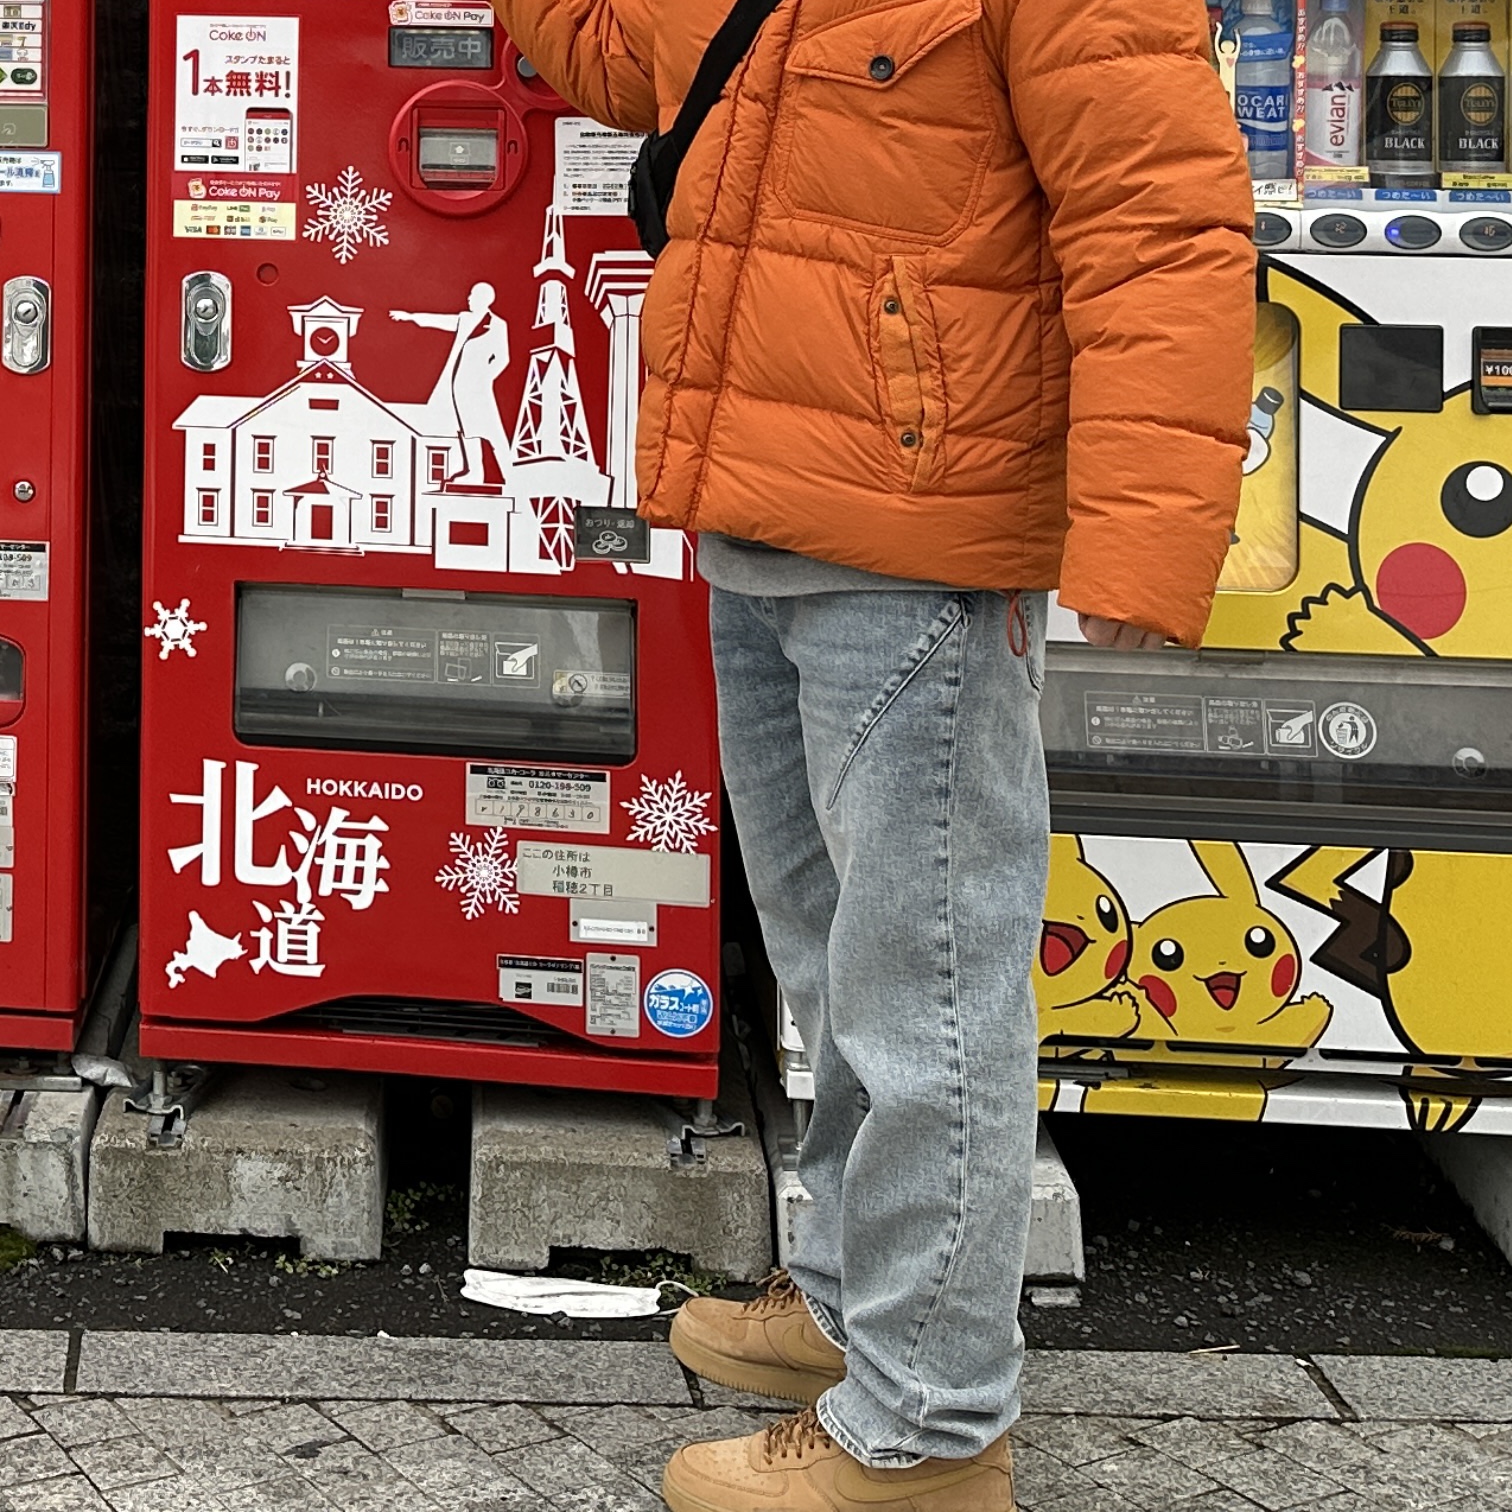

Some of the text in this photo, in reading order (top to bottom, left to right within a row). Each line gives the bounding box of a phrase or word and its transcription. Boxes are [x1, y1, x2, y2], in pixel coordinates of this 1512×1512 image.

[414, 9, 486, 24] Coke ON Pay
[209, 28, 267, 43] Coke ON
[401, 36, 482, 60] 販売中
[224, 54, 291, 65] スタンプたまると
[182, 48, 292, 99] 1本無料!
[1328, 92, 1346, 148] evian
[1384, 137, 1426, 150] BLACK
[1458, 138, 1500, 150] BLACK
[207, 184, 282, 202] Coke ON Pay
[306, 777, 424, 802] HOKKAIDO
[522, 848, 590, 863] ここの住所は
[167, 757, 391, 978] 北海道
[551, 865, 593, 878] 小樽市
[551, 879, 614, 897] 稲穂2丁目
